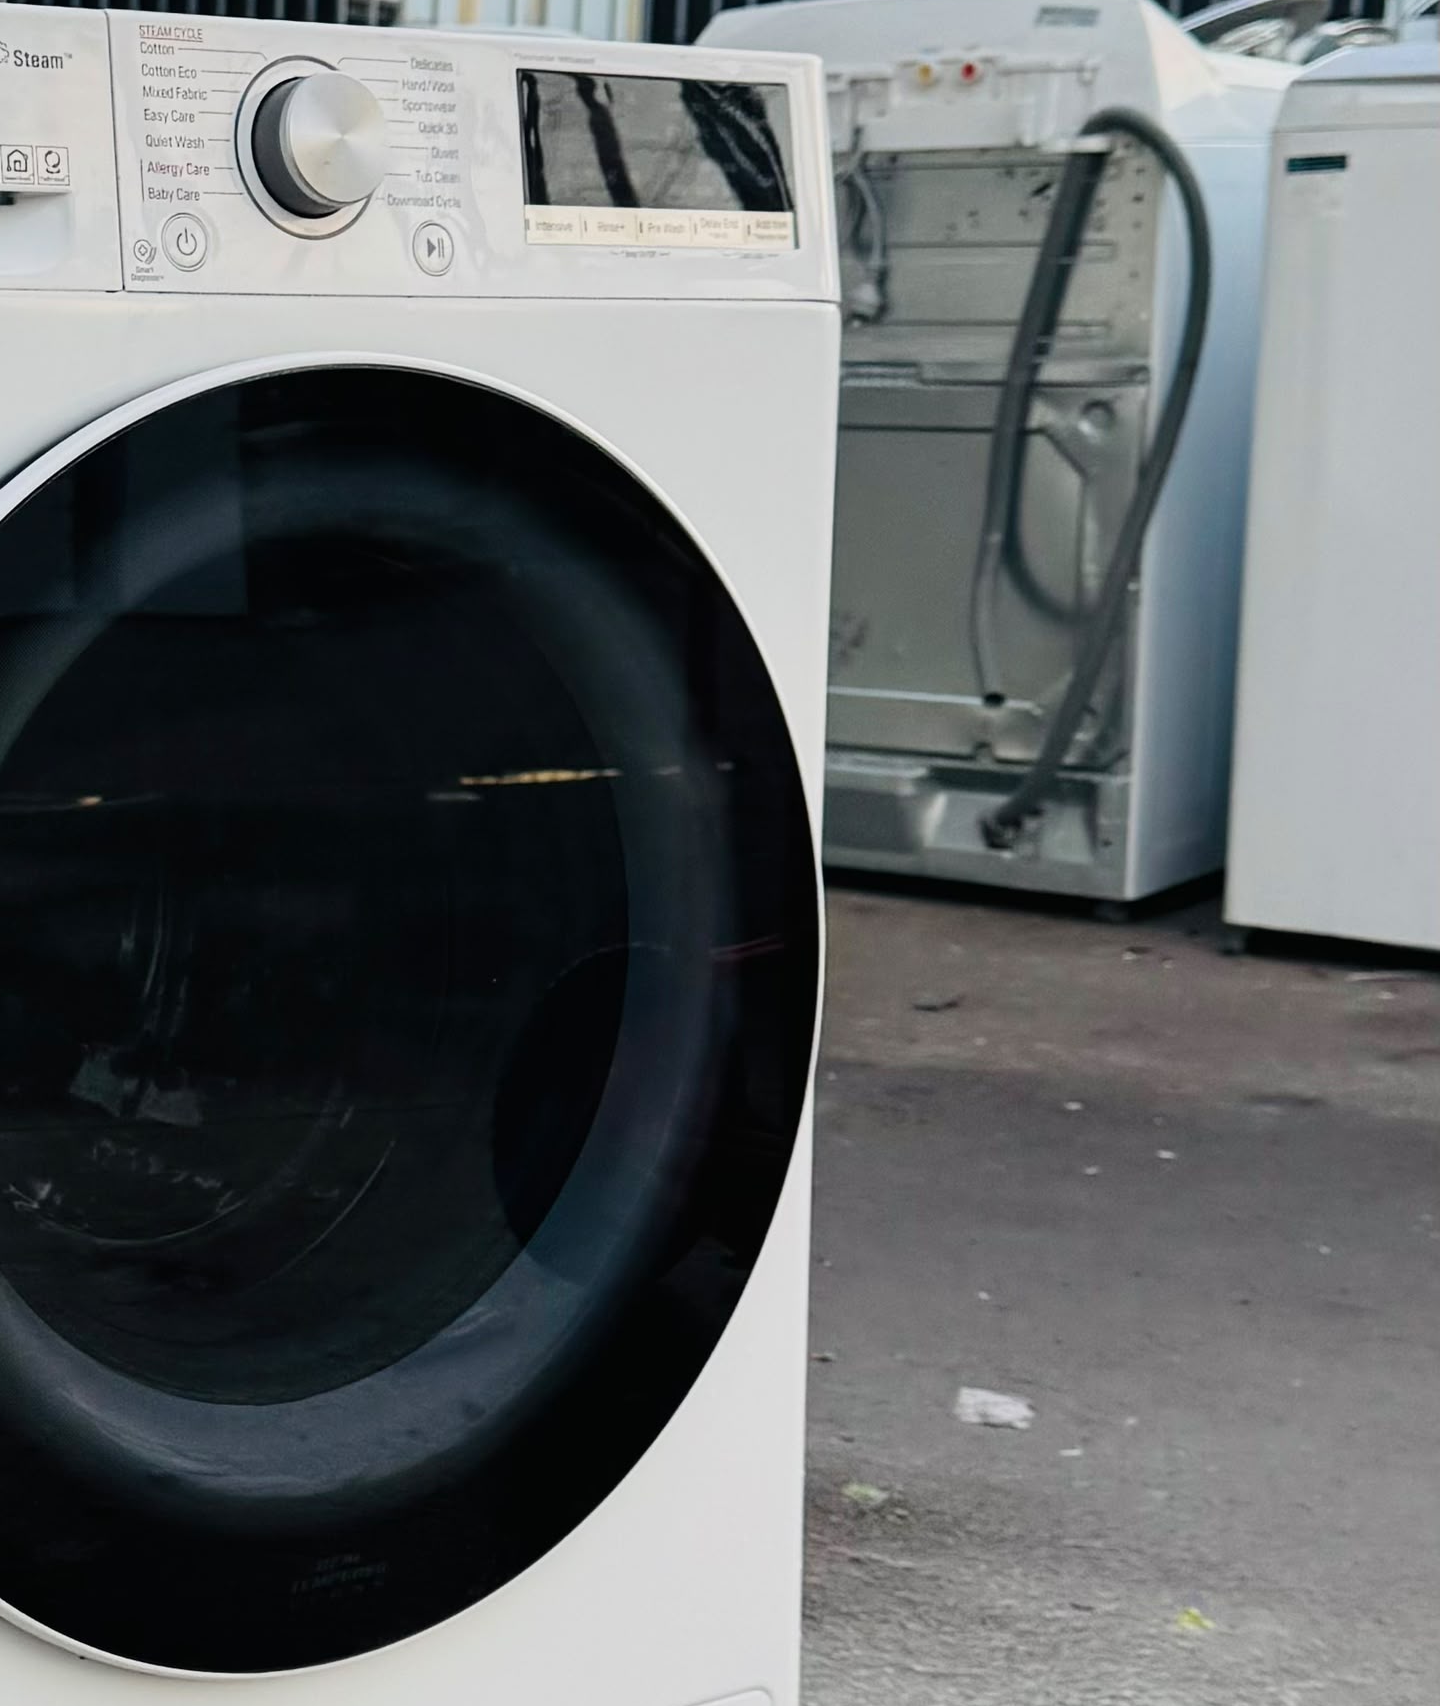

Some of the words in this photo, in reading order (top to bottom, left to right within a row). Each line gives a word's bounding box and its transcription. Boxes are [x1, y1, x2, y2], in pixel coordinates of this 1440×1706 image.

[139, 25, 172, 38] STEAM
[174, 28, 203, 40] CYCLE
[140, 41, 175, 55] Cotton
[141, 63, 176, 78] Cotton
[179, 66, 197, 79] Eco
[142, 85, 174, 99] Mixed
[176, 87, 208, 101] Fabric
[144, 108, 168, 124] Easy
[171, 110, 195, 123] Care
[145, 134, 172, 148] Quiet
[175, 136, 205, 149] Wash
[147, 161, 183, 177] Allergy
[186, 163, 210, 176] Care
[148, 187, 174, 203] Baby
[176, 188, 200, 201] Care
